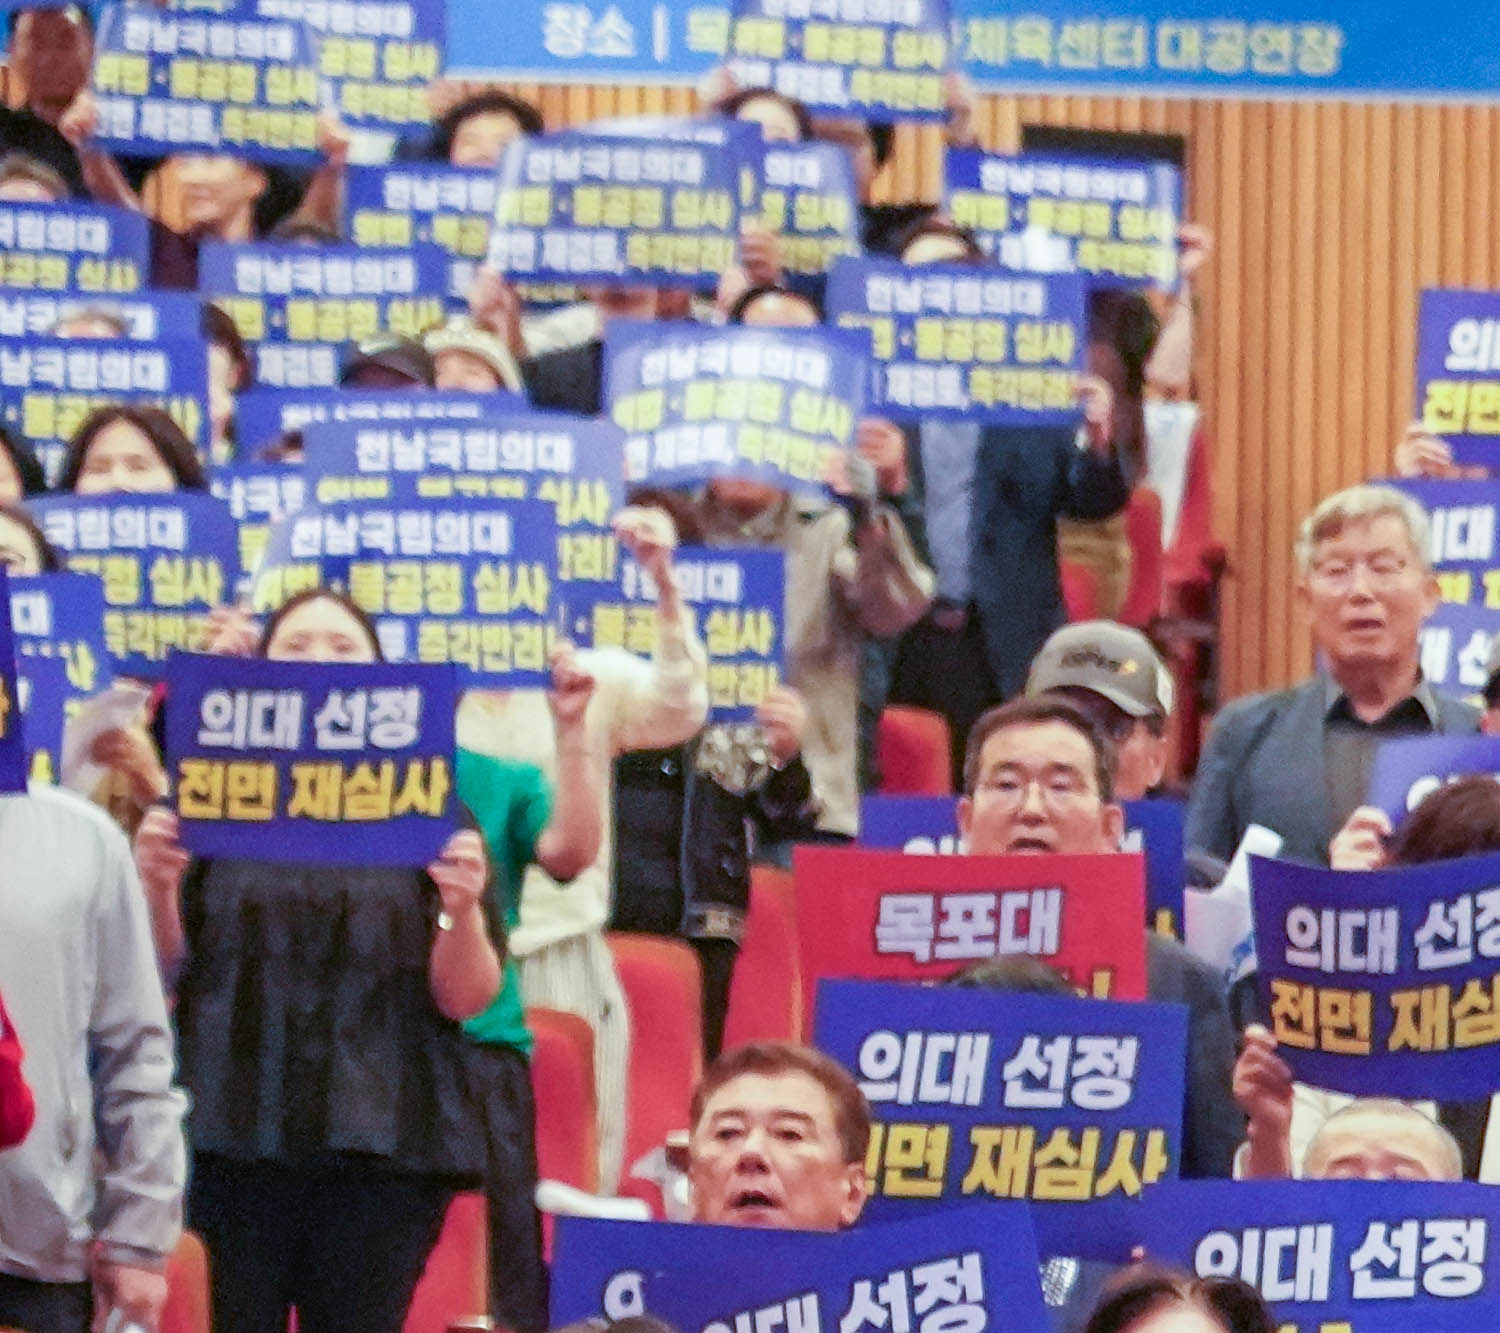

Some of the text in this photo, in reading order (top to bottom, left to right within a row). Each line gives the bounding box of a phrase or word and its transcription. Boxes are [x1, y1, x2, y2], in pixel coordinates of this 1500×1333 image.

[199, 688, 421, 749] 의대 선정
[179, 760, 449, 820] 전면 재심사
[876, 889, 1061, 962] 목포대
[1286, 907, 1399, 973] 의대
[1261, 981, 1371, 1053] 전면
[858, 1032, 1137, 1109] 의대 선정
[963, 1128, 1166, 1199] 재심사
[1350, 1219, 1486, 1298] 선정
